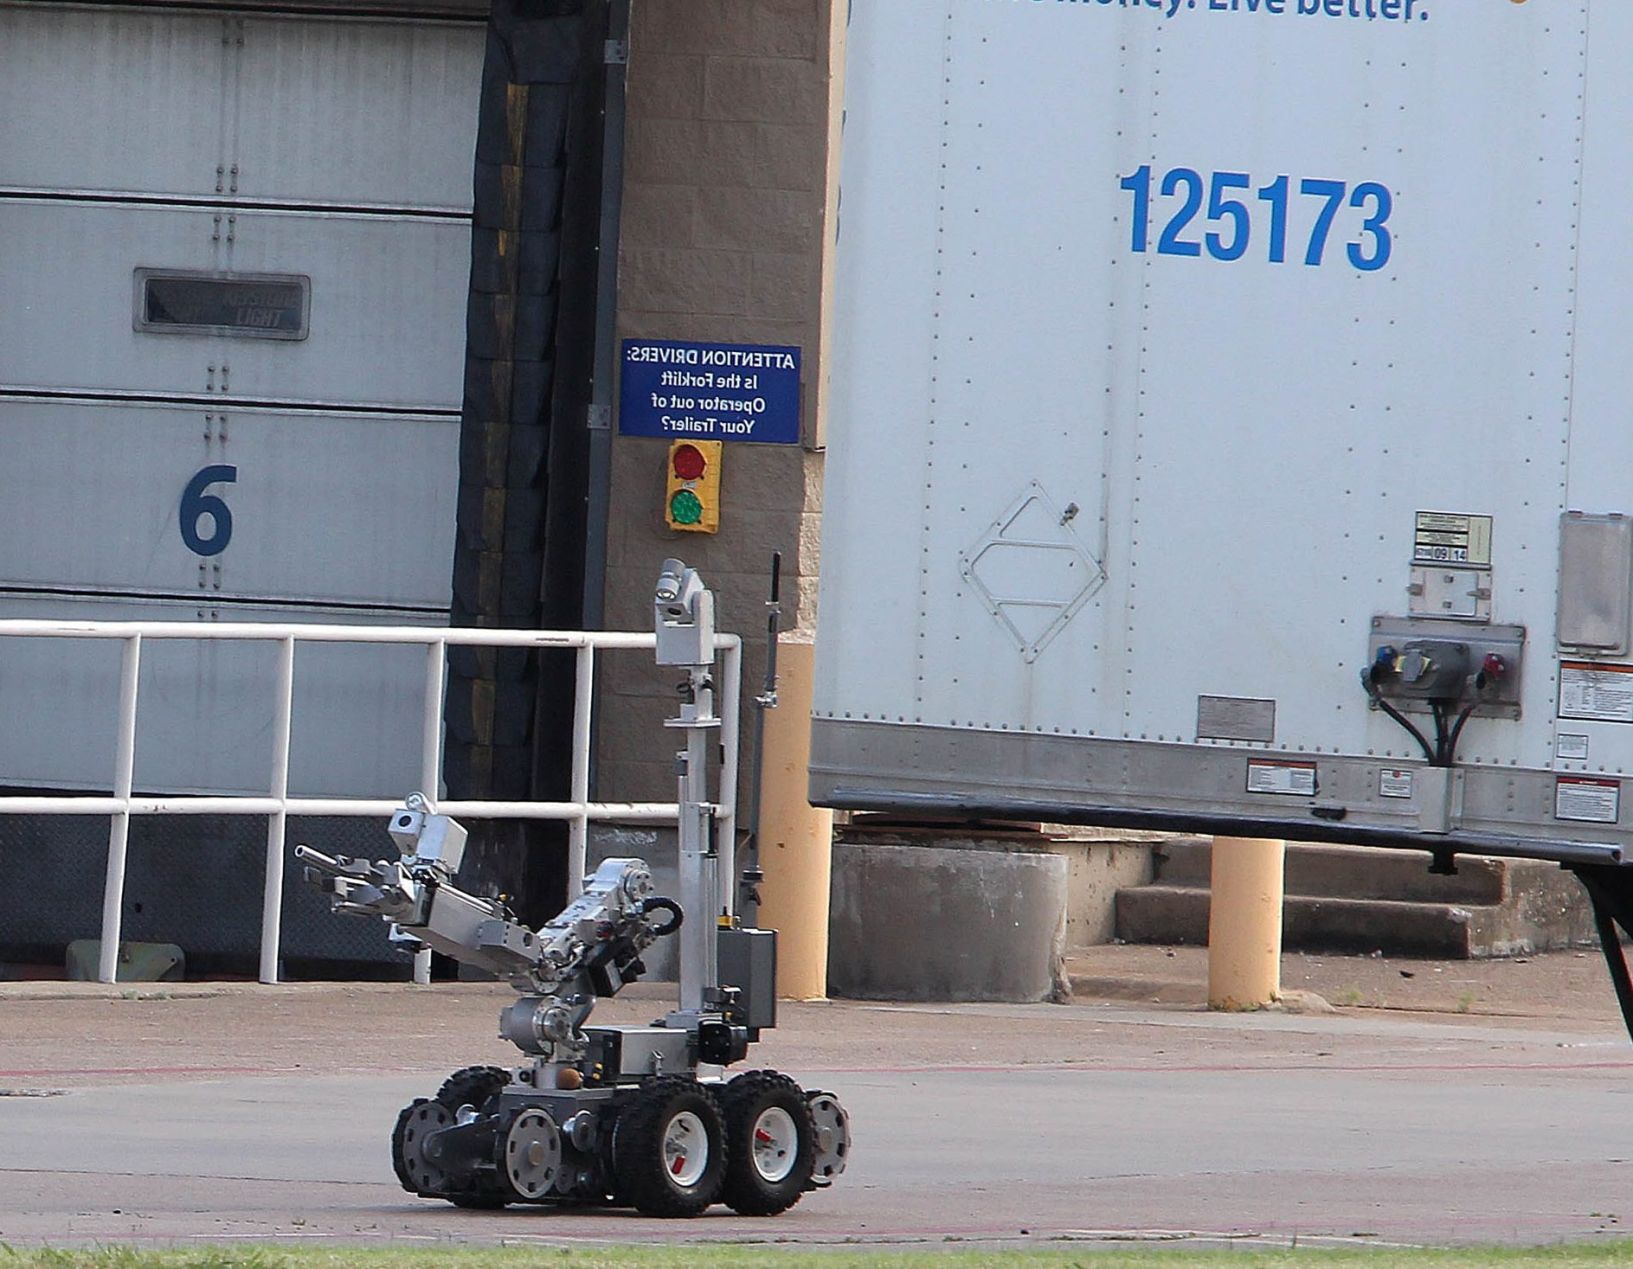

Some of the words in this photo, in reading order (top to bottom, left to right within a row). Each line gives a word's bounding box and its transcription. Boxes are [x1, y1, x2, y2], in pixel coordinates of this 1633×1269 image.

[1119, 164, 1393, 272] 125173
[236, 308, 285, 328] LIGHT
[179, 464, 237, 557] 6
